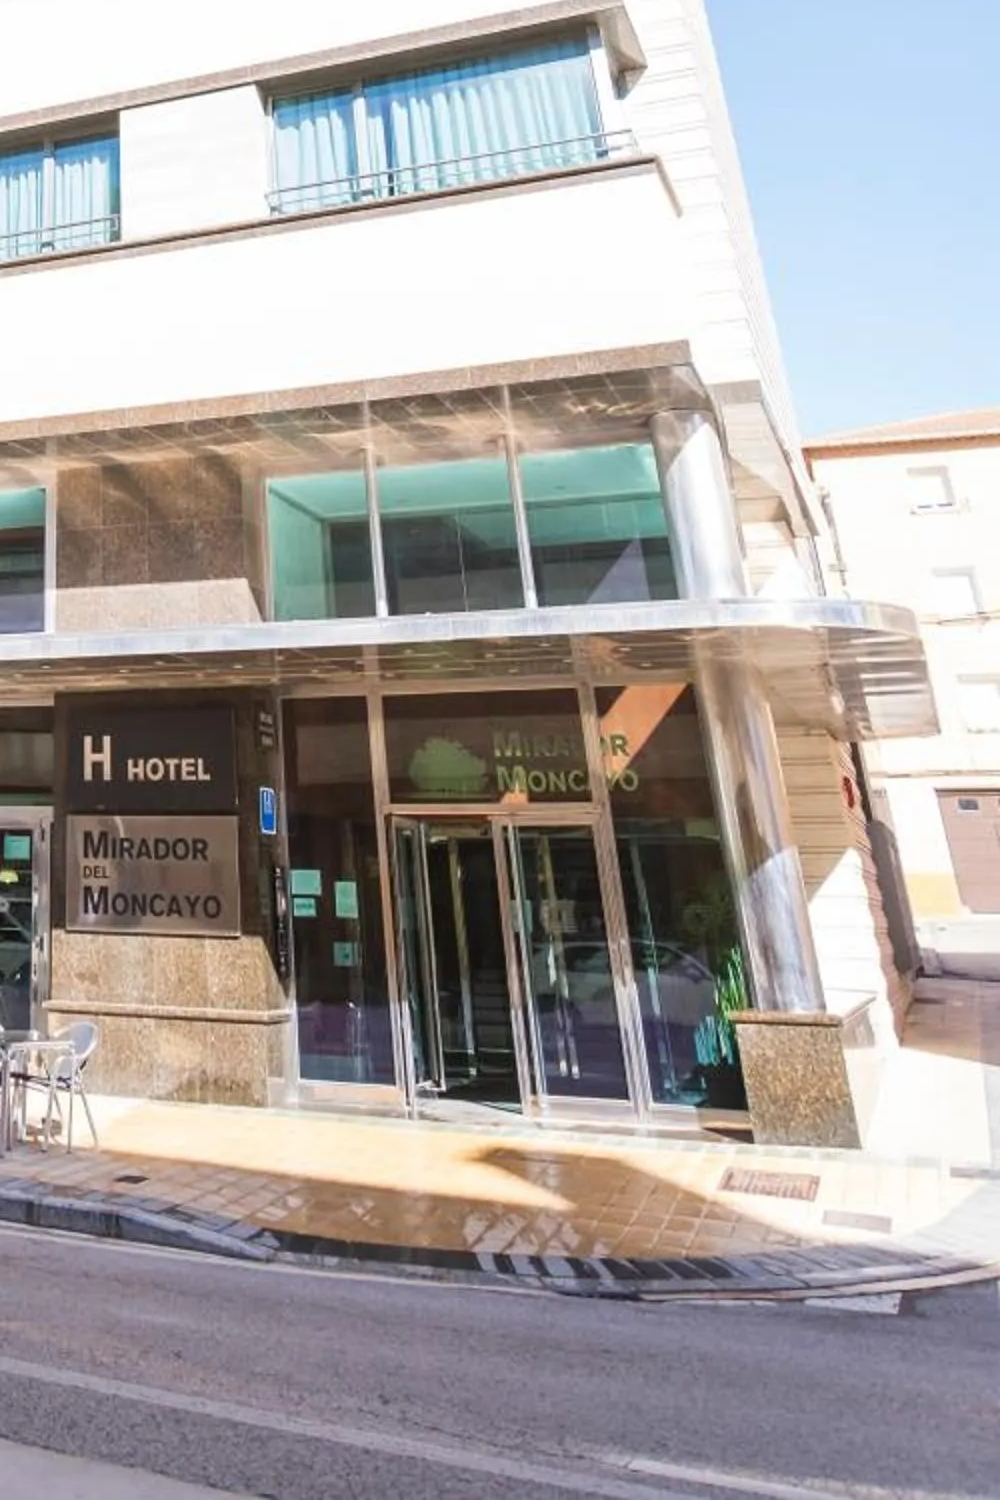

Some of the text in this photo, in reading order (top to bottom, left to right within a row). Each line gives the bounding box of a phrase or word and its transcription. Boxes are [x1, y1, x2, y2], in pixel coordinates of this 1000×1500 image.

[83, 735, 211, 781] H HOTEL
[496, 765, 639, 793] MONCYO
[83, 831, 209, 860] MIRADOR
[83, 865, 110, 879] DEL
[83, 885, 222, 919] MONCAYO
